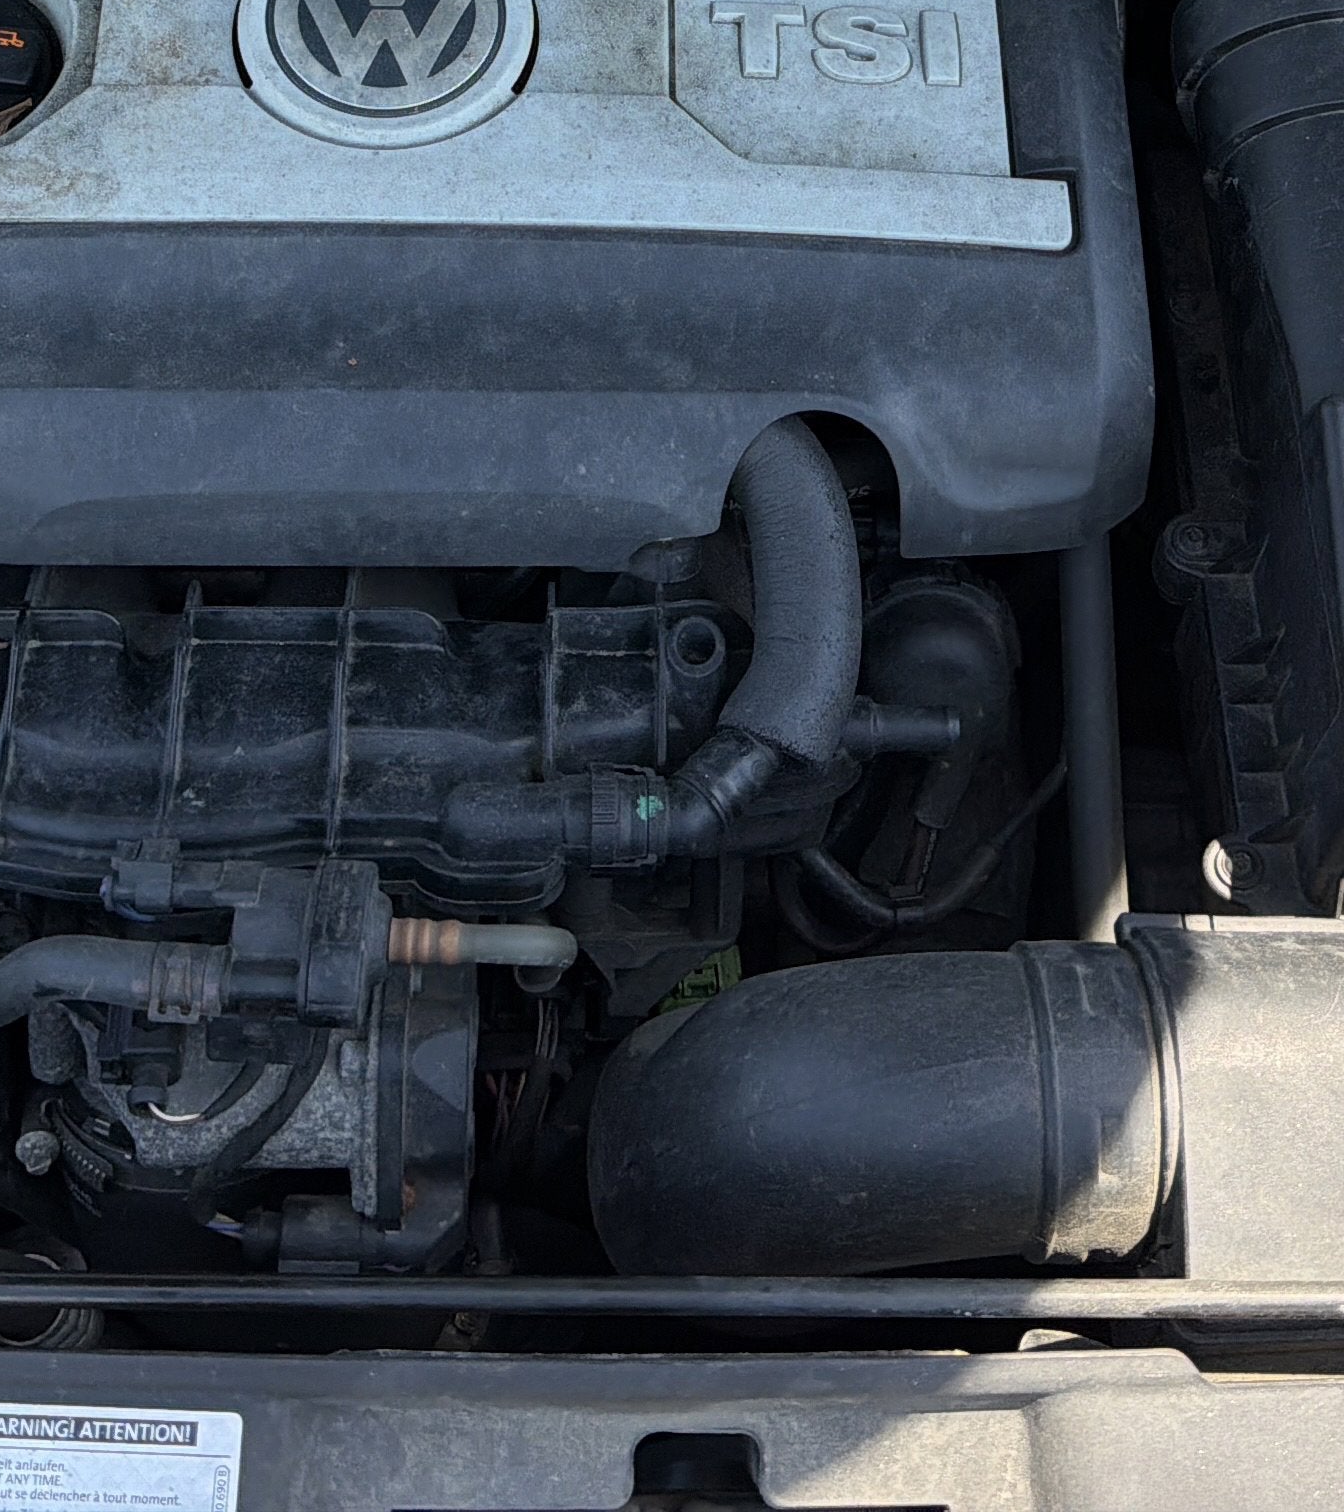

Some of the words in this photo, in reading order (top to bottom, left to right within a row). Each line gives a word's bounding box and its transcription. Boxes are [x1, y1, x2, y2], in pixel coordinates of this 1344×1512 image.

[710, 0, 964, 88] TSI
[79, 1421, 192, 1443] ATTENTION!
[15, 1459, 68, 1473] anlaufen.
[6, 1472, 31, 1485] ANY
[32, 1474, 64, 1486] TIME.
[15, 1490, 28, 1500] se
[93, 1490, 101, 1502] à
[103, 1492, 127, 1504] tout
[130, 1494, 182, 1506] moment.
[216, 1479, 227, 1500] 690
